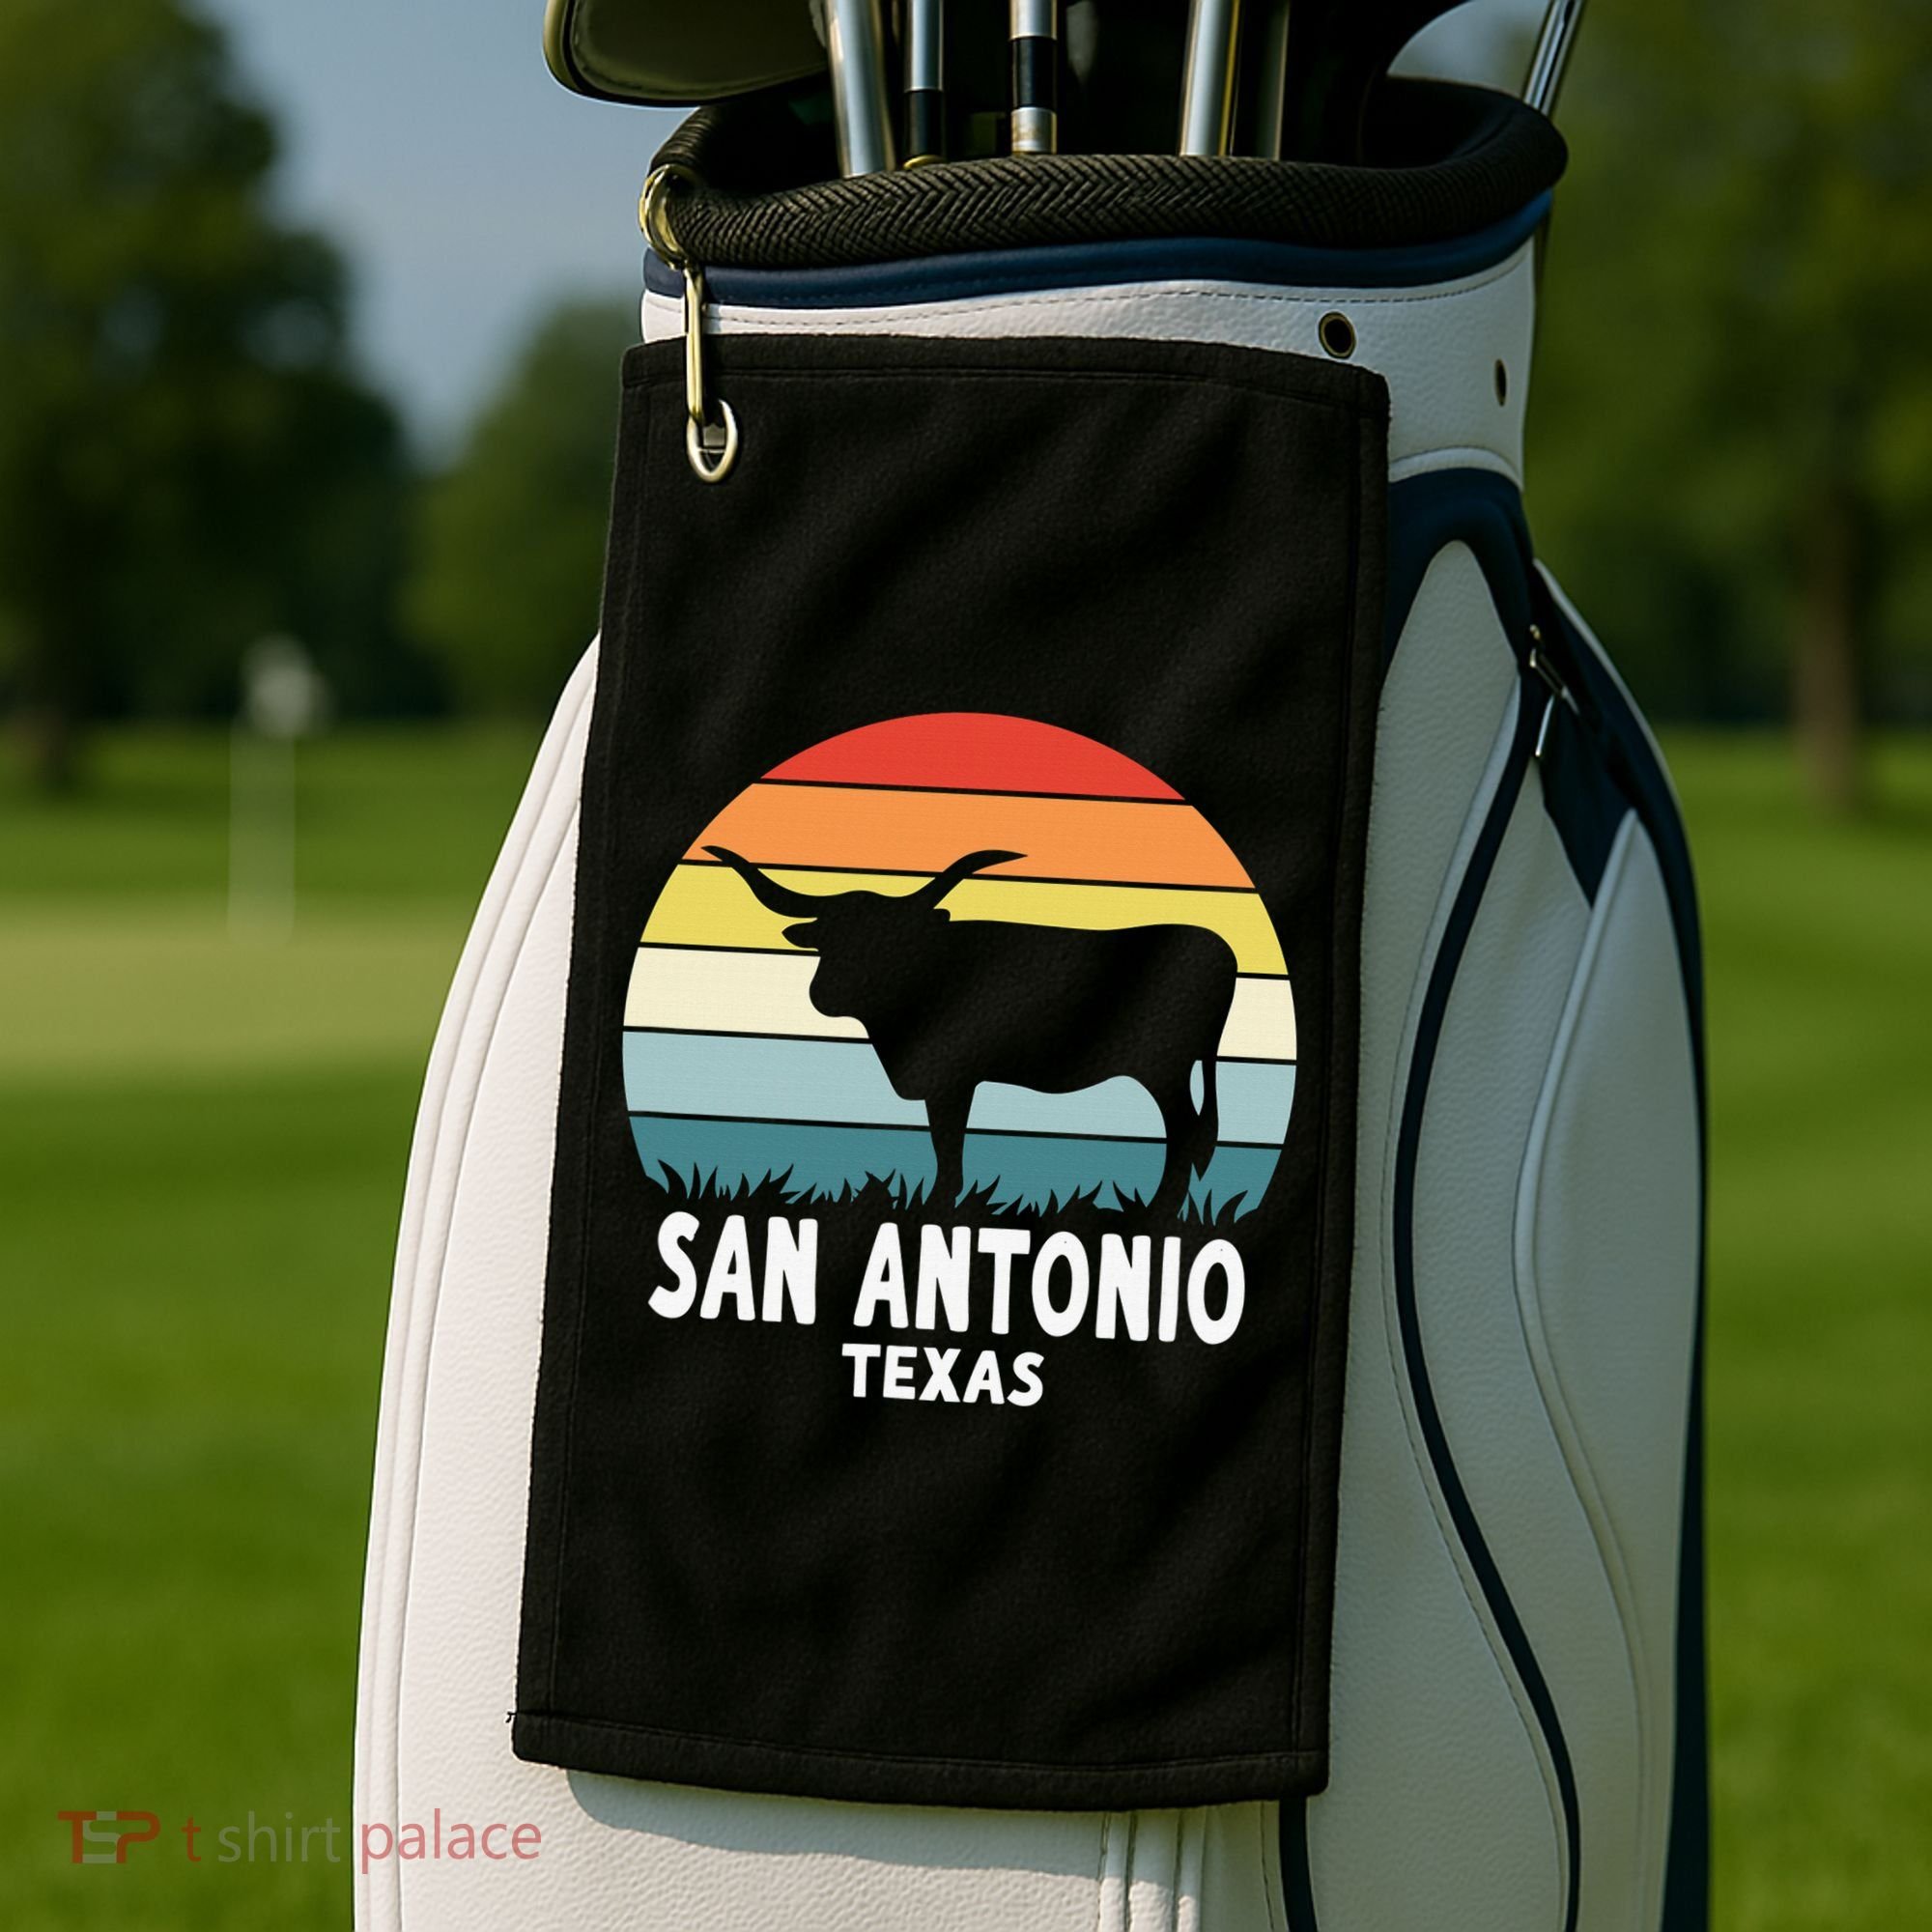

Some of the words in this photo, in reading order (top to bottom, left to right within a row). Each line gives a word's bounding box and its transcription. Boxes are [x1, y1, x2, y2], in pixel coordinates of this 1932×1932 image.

[648, 1210, 818, 1325] SAN
[853, 1222, 1246, 1345] ANTONIO
[841, 1343, 1044, 1407] TEXAS
